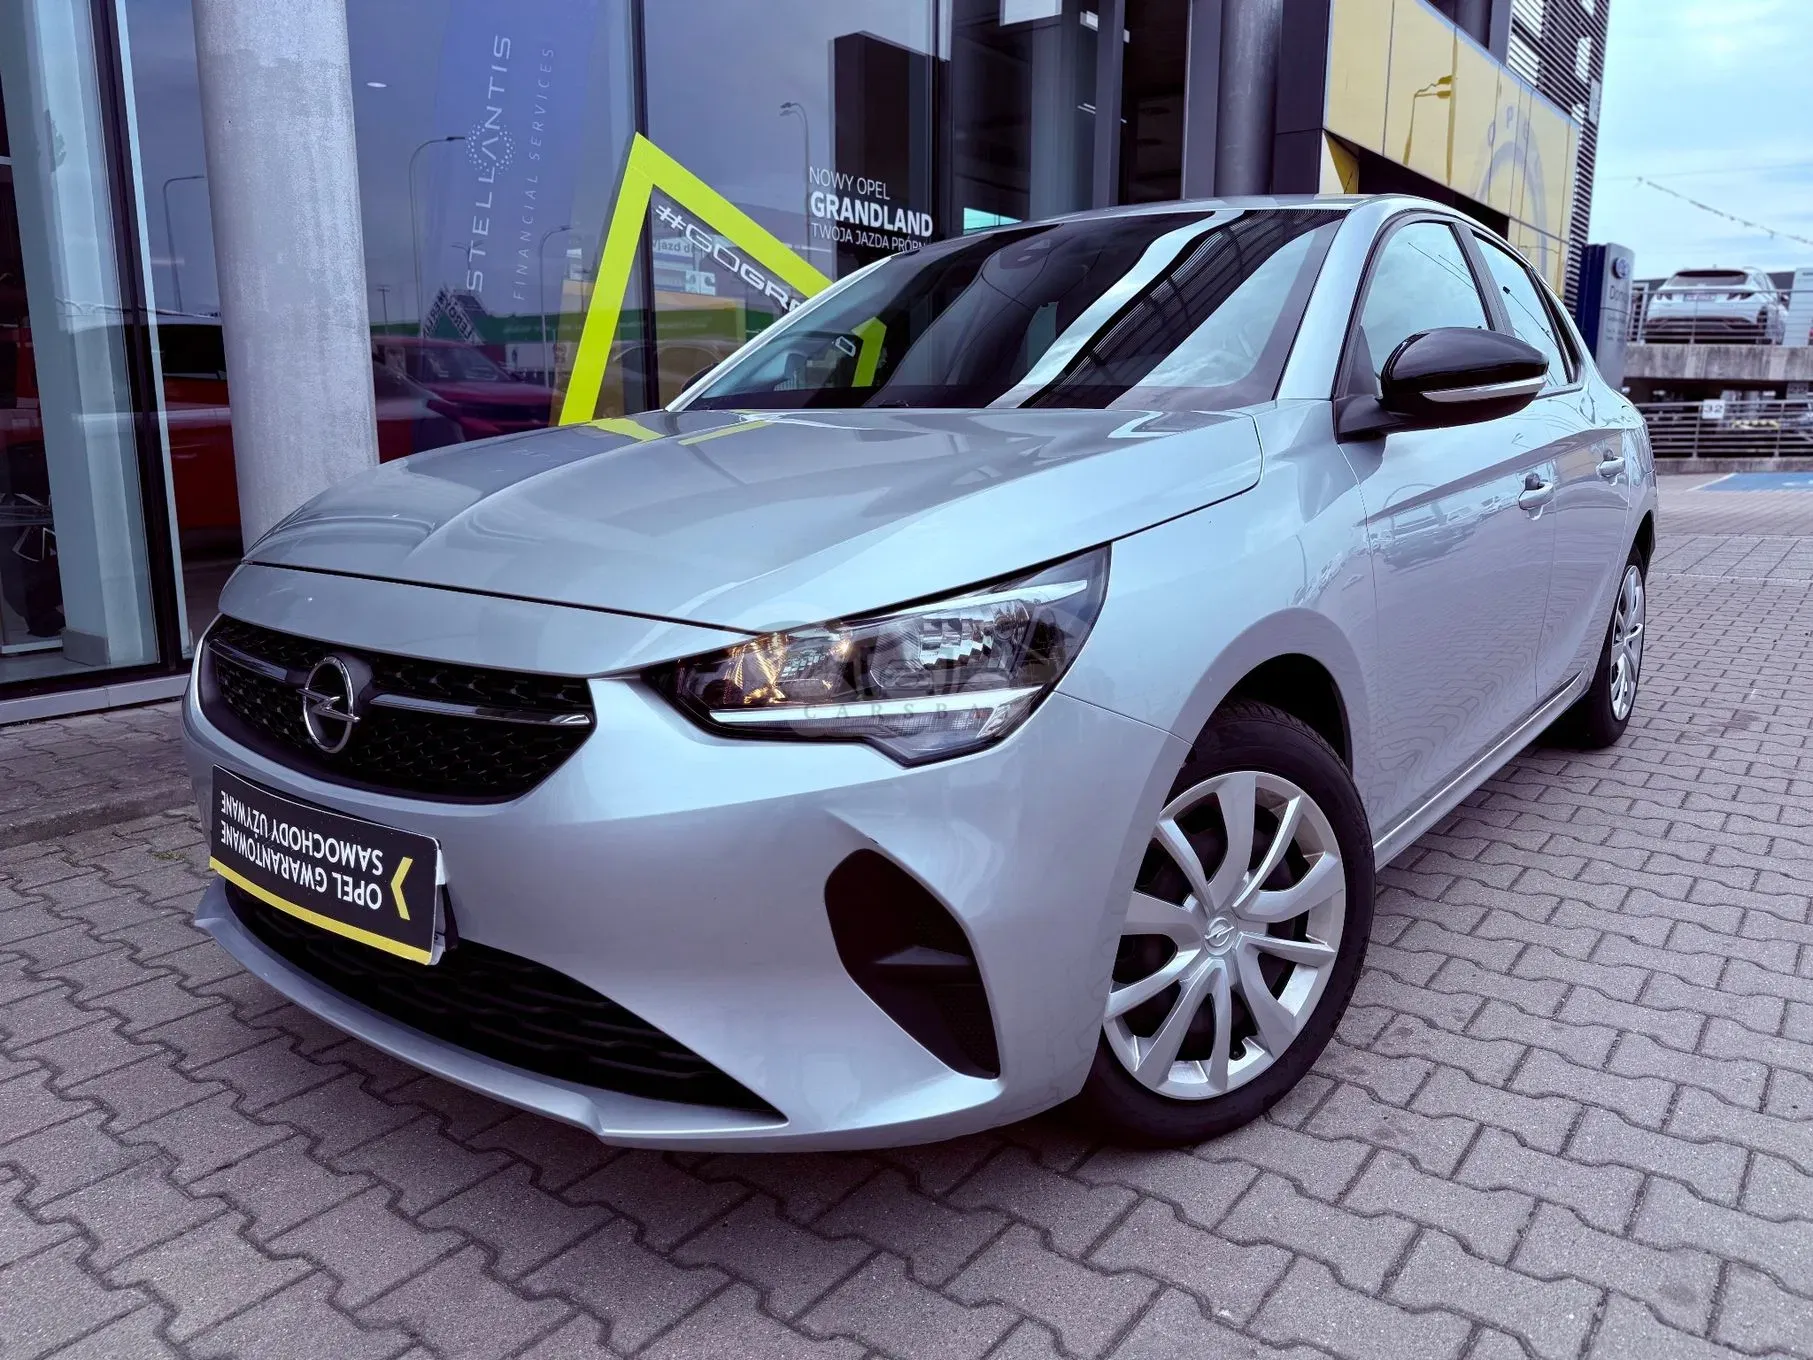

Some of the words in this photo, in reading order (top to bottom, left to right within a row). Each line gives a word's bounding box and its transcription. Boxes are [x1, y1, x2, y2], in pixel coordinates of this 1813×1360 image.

[466, 35, 511, 293] STELLANTIS
[513, 176, 538, 301] FINANCIAL
[529, 49, 554, 161] SERVICES
[809, 165, 854, 192] NOWY
[856, 177, 891, 200] OPEL
[810, 190, 933, 238] GRANDLAND
[811, 222, 854, 244] TWOJA
[855, 230, 890, 250] JAZDA
[220, 790, 268, 839] UŻYWANE
[220, 820, 328, 893] GWARANTOWANE
[270, 818, 384, 876] SAMOCHODY
[331, 871, 383, 910] OPEL
